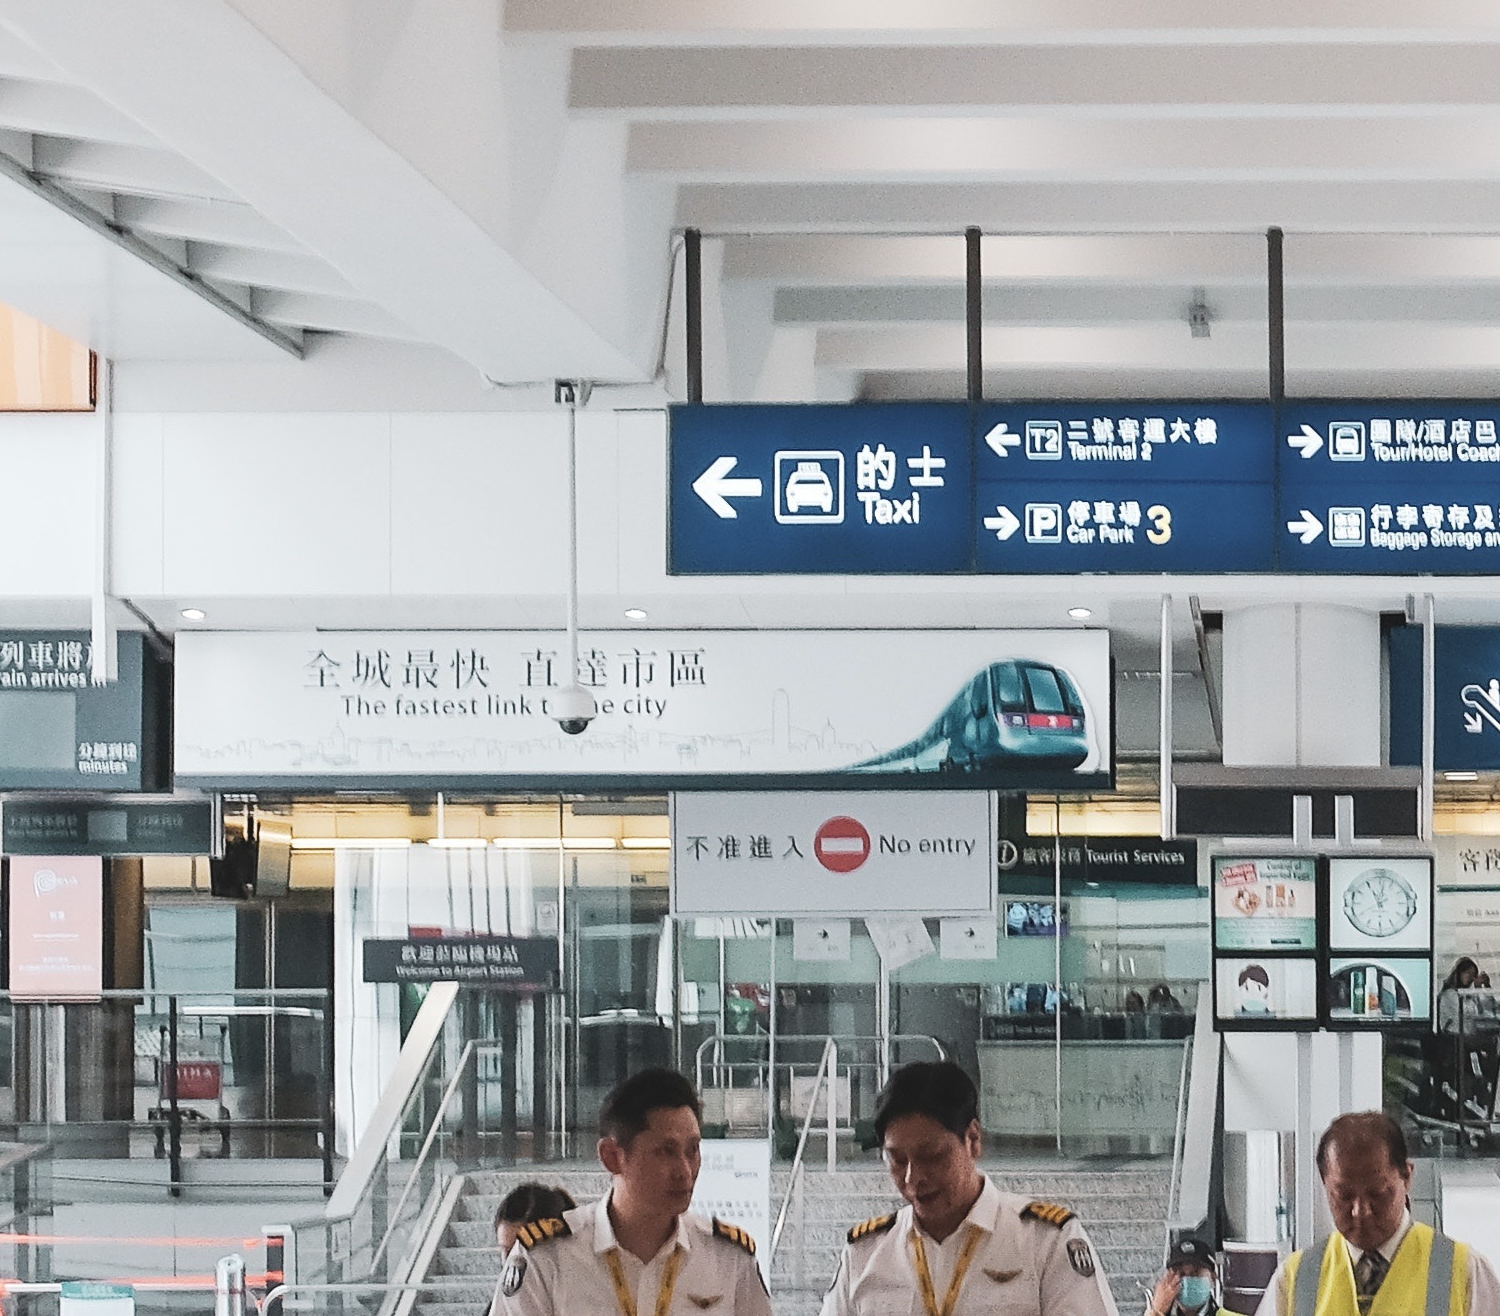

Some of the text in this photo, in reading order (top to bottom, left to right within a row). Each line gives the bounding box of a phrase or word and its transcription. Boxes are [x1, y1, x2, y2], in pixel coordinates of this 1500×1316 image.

[1066, 416, 1218, 445] 二號客運大樓
[1066, 439, 1153, 462] Terminal 2
[1370, 442, 1453, 462] Tour/Hotel
[856, 443, 947, 491] 的士
[856, 491, 921, 525] Taxi
[1066, 500, 1142, 527] 停車場
[1033, 506, 1057, 539] P
[1066, 524, 1135, 544] Car Park
[1146, 504, 1172, 545] 3
[1369, 528, 1428, 551] Baggage
[1430, 528, 1483, 551] Storage
[30, 668, 87, 688] arrives
[303, 647, 708, 689] 全城最快 直達市區
[340, 694, 387, 716] The
[394, 693, 478, 717] fastest
[487, 693, 533, 716] link
[622, 693, 668, 719] city
[78, 759, 129, 775] minutes
[686, 834, 805, 861] 不准進入
[879, 834, 977, 857] No entry
[1086, 847, 1186, 866] Tourist Services
[395, 964, 525, 979] Welcome to Airport Station
